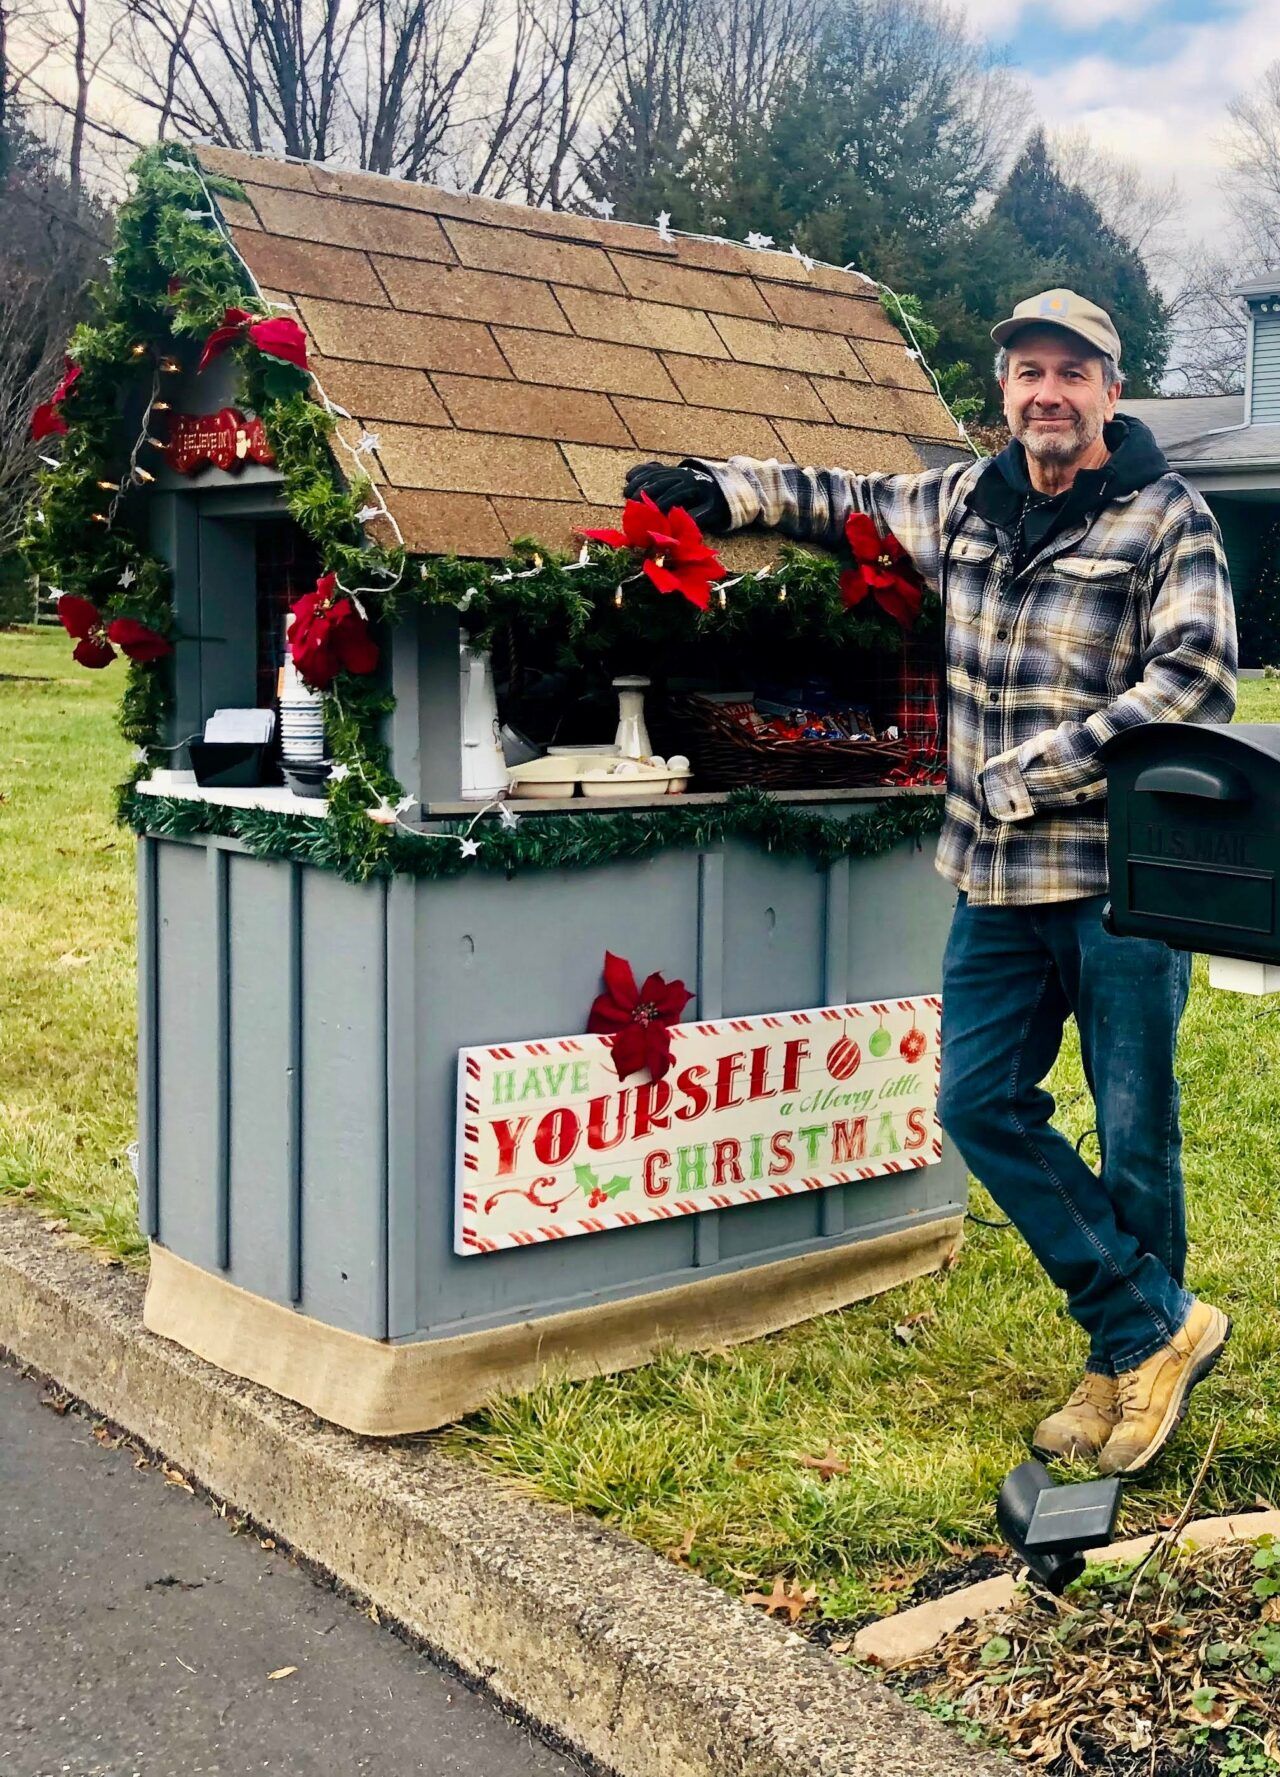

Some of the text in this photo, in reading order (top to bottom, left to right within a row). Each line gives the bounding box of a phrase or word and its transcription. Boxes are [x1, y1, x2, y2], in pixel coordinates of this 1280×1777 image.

[1194, 830, 1256, 865] MAIL
[492, 1060, 591, 1106] HAVE
[780, 1073, 925, 1117] a Merry little
[488, 1038, 812, 1178] YOURSELF
[642, 1106, 928, 1198] CHRISTMAS
